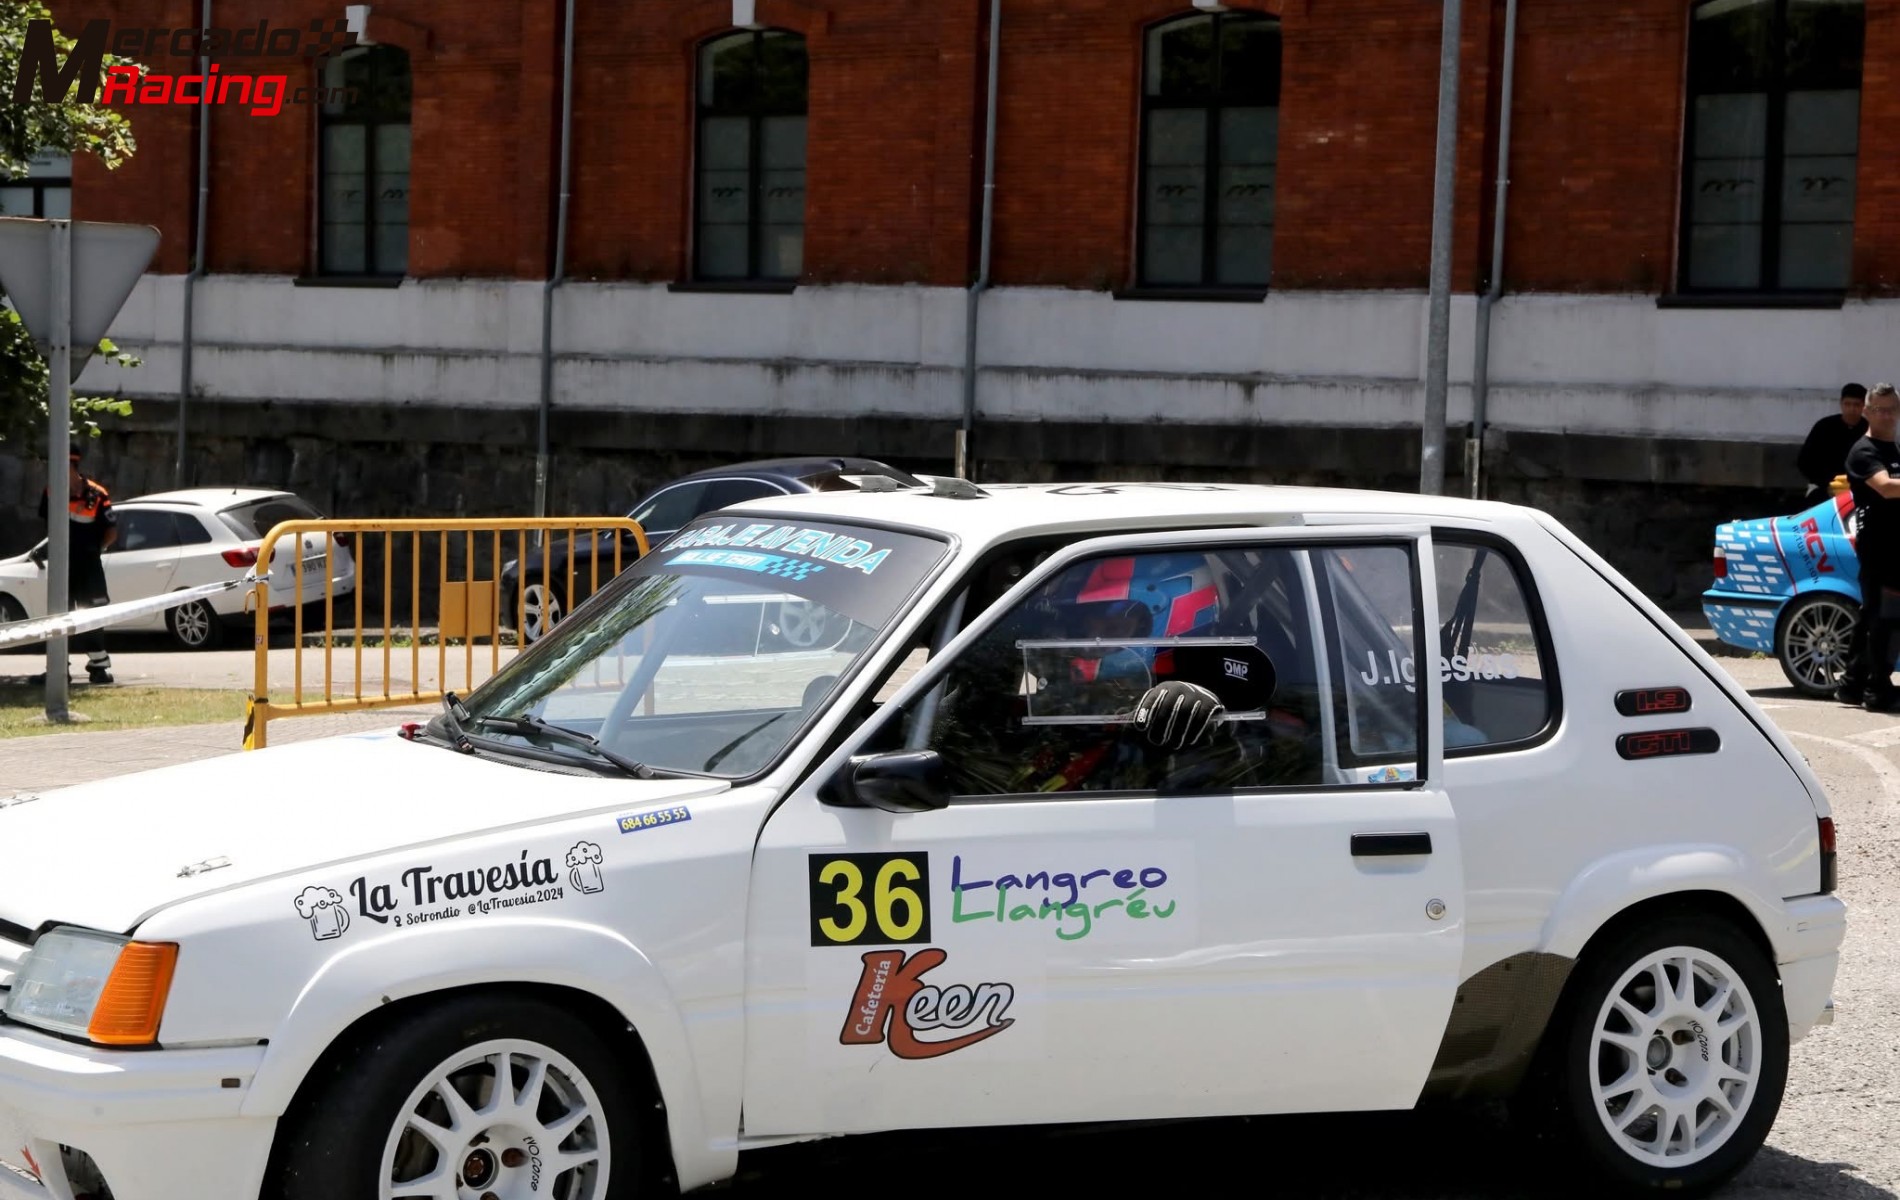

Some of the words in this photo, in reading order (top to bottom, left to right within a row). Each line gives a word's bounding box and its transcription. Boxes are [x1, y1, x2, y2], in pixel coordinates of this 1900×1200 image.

[661, 523, 774, 552] GARAJE
[760, 525, 892, 575] AVENIDA
[1800, 517, 1835, 573] RCV
[1223, 661, 1249, 677] OMP
[621, 816, 642, 831] 684
[642, 813, 658, 826] 66
[658, 810, 672, 823] 55
[672, 807, 687, 820] 55
[350, 877, 398, 924] La
[402, 850, 559, 906] Travesía
[817, 858, 924, 943] 36
[950, 855, 1168, 909] Langreo
[406, 907, 461, 926] Sotrondio
[951, 884, 1176, 941] Llangréu
[839, 948, 1016, 1060] Keen
[855, 959, 892, 1036] Cafetería
